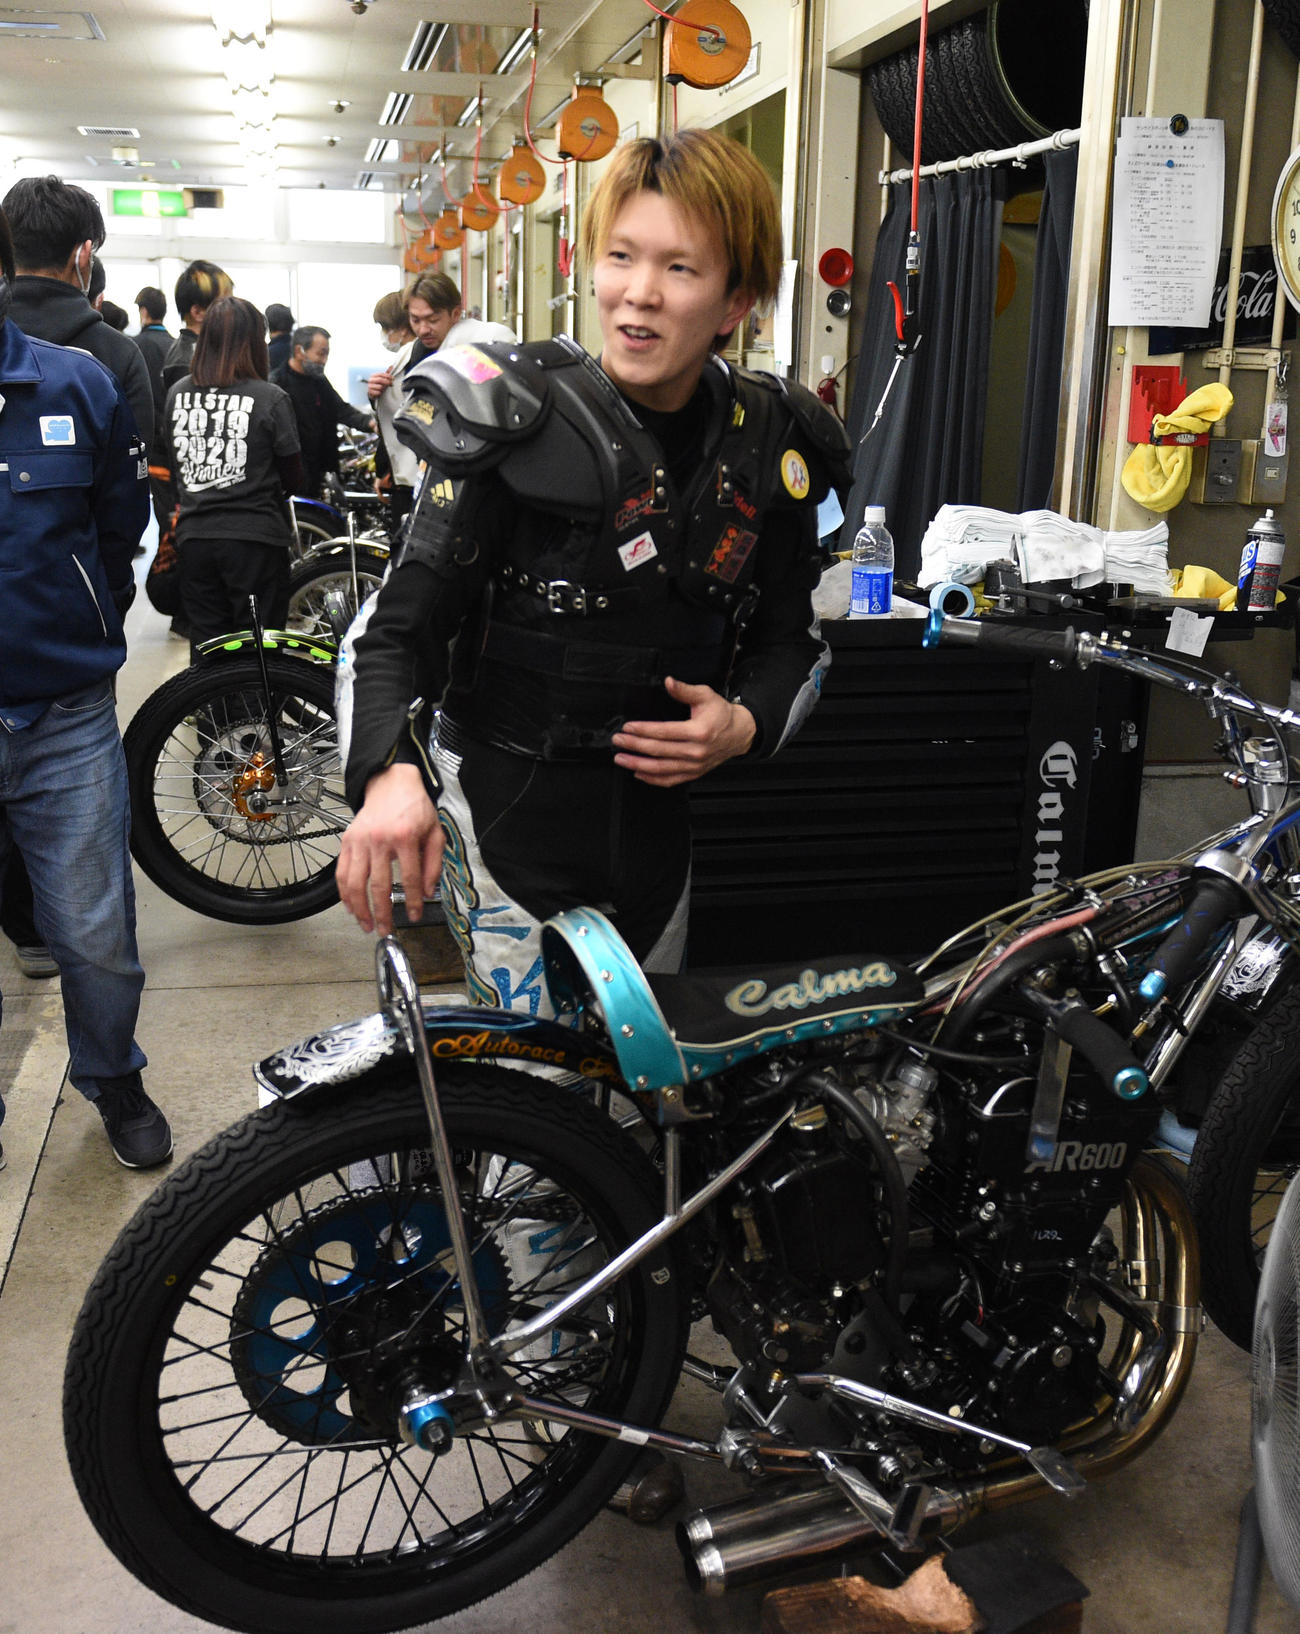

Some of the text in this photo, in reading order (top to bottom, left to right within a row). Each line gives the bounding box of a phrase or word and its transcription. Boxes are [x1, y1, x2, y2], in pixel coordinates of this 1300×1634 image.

[172, 408, 249, 439] 2019
[173, 436, 248, 467] 2020
[724, 962, 897, 1017] Calma
[432, 1031, 566, 1062] Autorace
